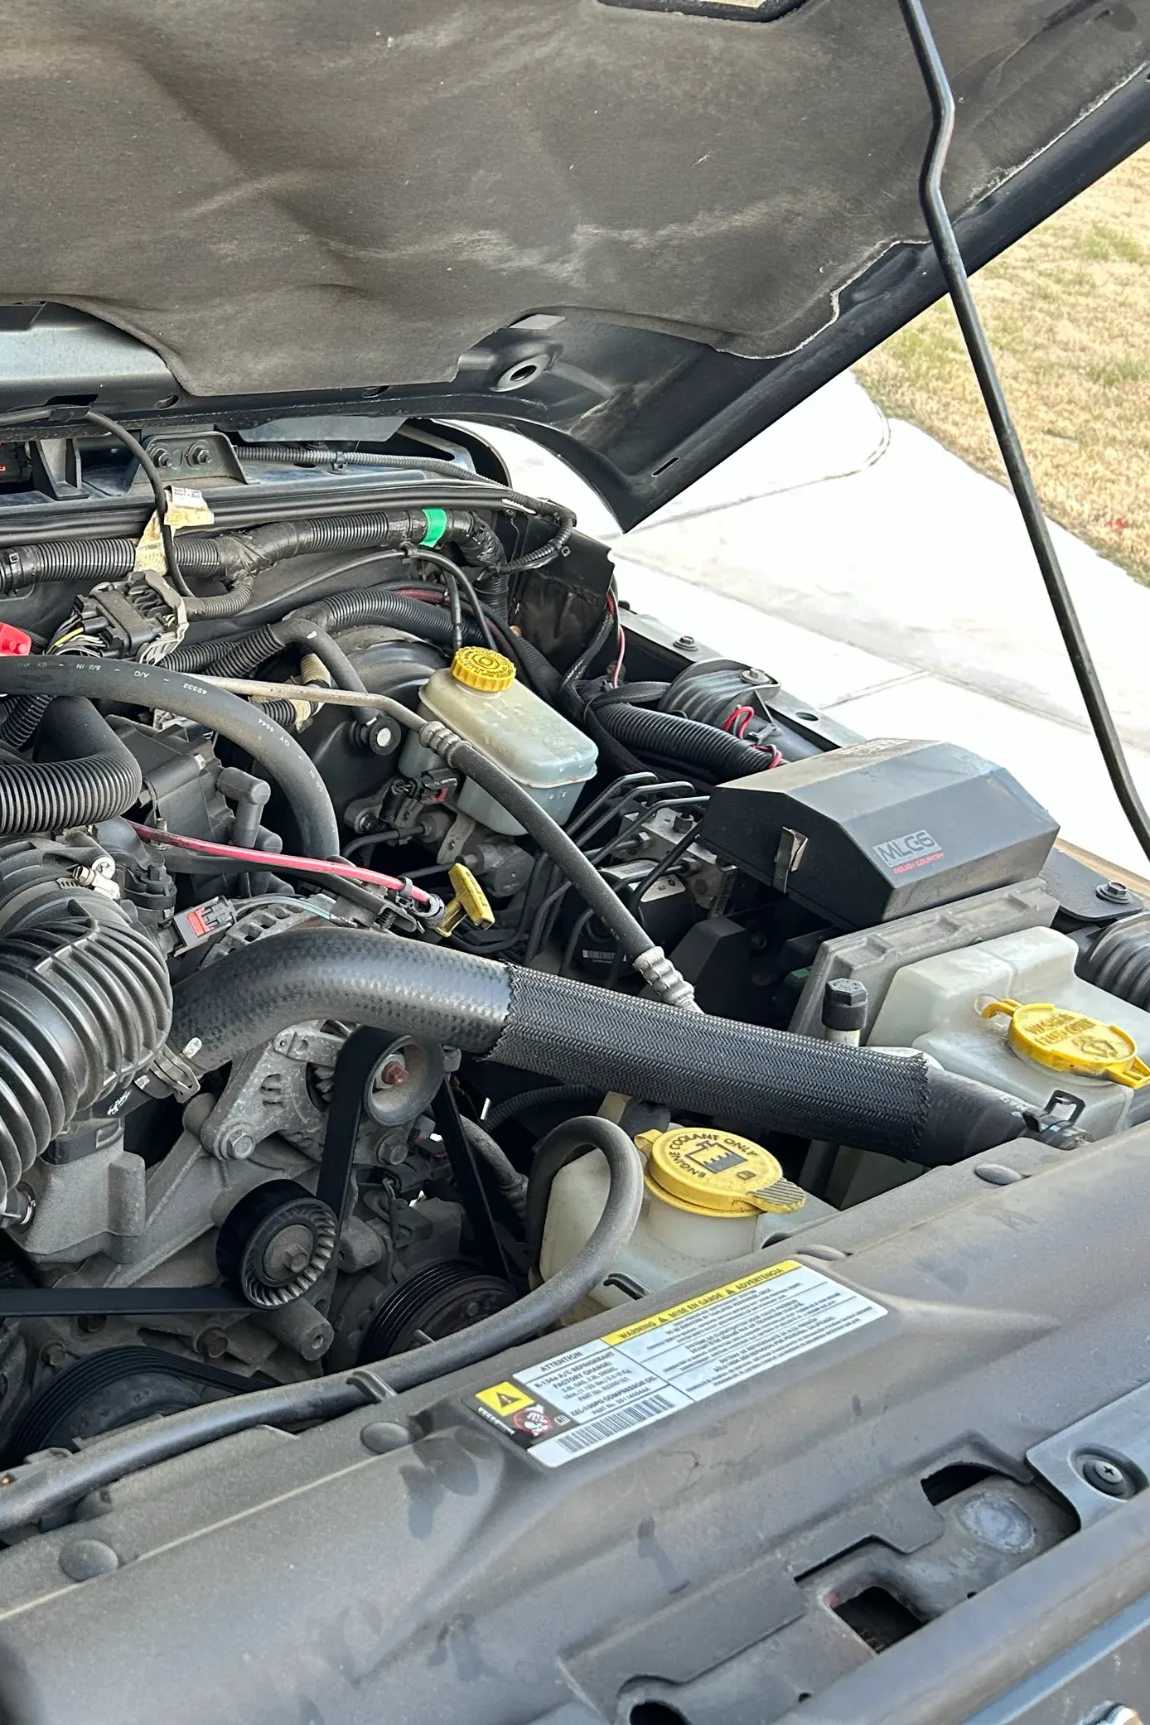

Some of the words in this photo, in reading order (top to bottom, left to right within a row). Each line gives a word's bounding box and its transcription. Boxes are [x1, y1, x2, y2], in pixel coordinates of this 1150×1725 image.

[668, 1132, 720, 1151] COOLANT
[724, 1137, 760, 1158] ONLY
[668, 1150, 708, 1179] ENGINE
[617, 1320, 657, 1340] WARNING
[667, 1305, 688, 1319] MISE
[687, 1302, 700, 1313] EN
[697, 1292, 725, 1309] GARDE
[735, 1267, 783, 1291] ADVERTENCIA
[539, 1350, 584, 1373] ATTENTION
[570, 1351, 616, 1374] REFRIGERANT
[551, 1372, 584, 1389] FACTORY
